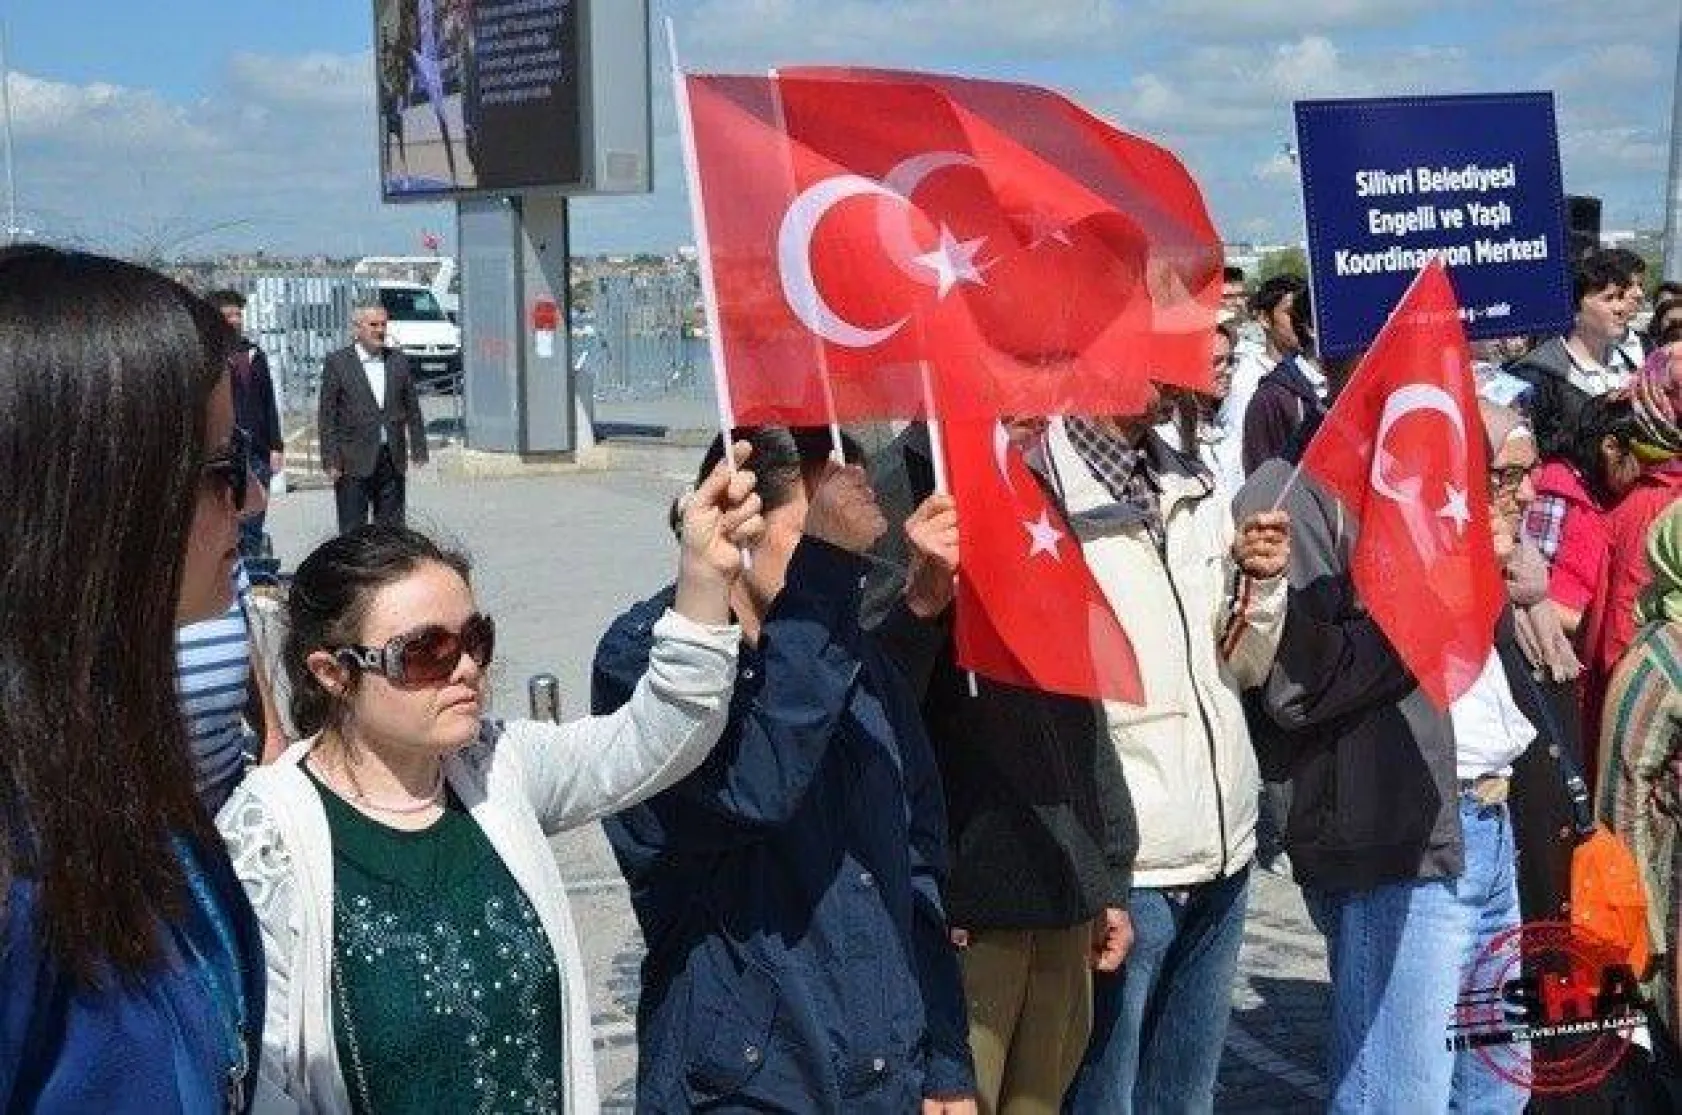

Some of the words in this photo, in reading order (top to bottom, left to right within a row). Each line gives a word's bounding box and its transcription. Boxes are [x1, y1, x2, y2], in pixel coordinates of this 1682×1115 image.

[1355, 169, 1413, 197] Silivri
[1417, 163, 1516, 192] Belediyesi
[1368, 206, 1436, 236] Engelli
[1440, 209, 1463, 230] ve
[1467, 201, 1512, 230] Yaşlı
[1475, 234, 1548, 263] Merkezi
